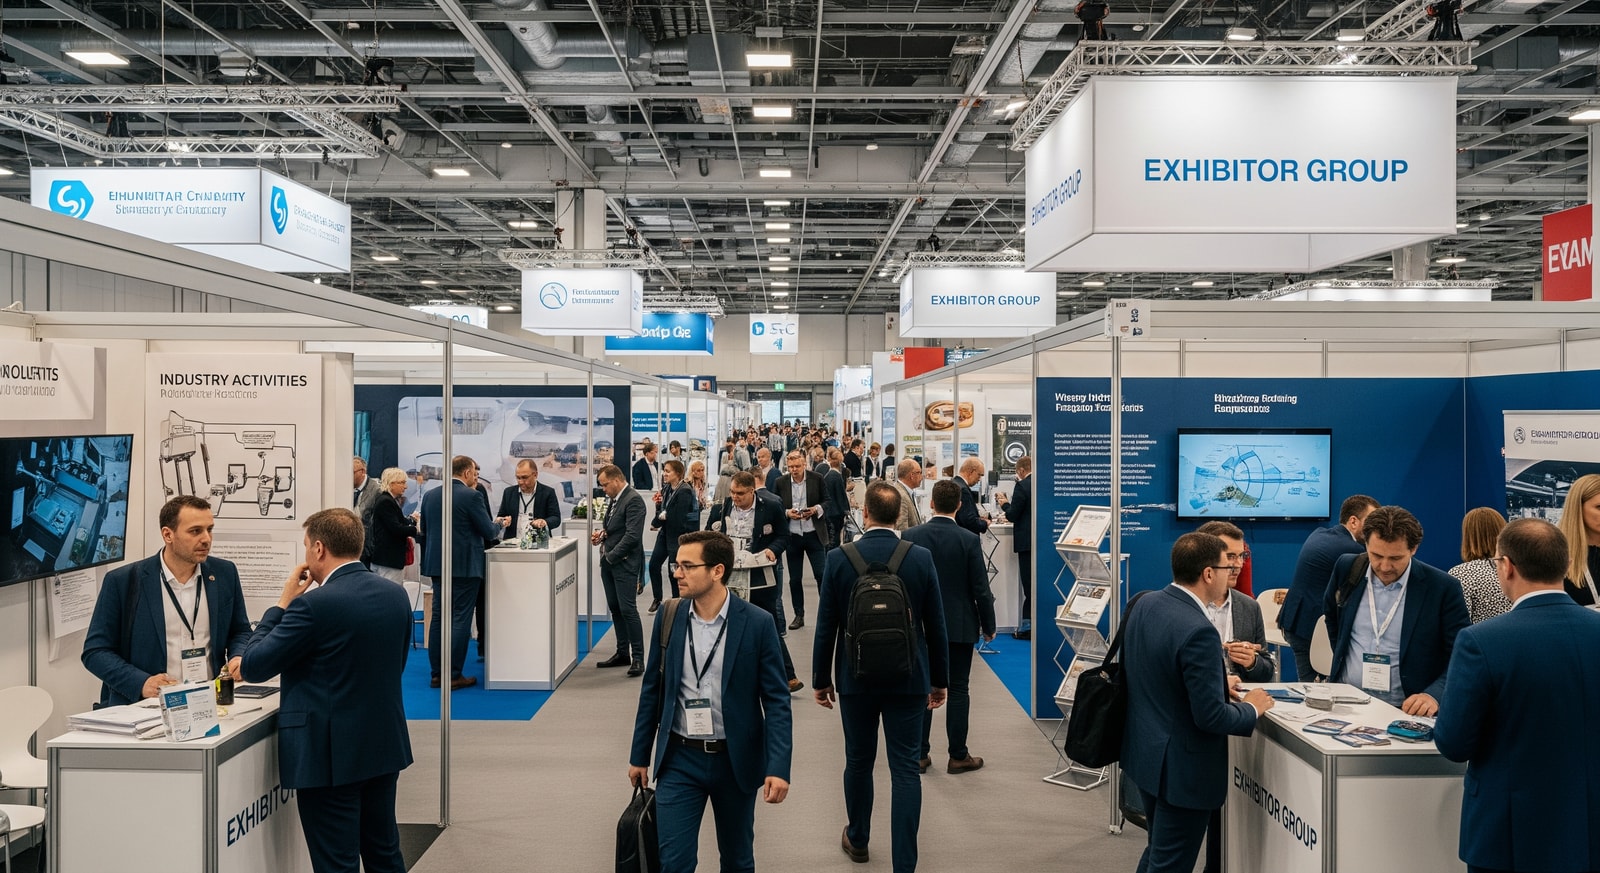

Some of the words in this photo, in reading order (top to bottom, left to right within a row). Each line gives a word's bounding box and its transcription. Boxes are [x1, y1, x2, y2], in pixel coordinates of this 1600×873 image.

[1144, 158, 1298, 182] EXHIBITOR
[1306, 158, 1408, 182] GROUP
[1059, 168, 1082, 205] GROUP
[931, 295, 995, 305] EXHIBITOR
[998, 295, 1041, 305] GROUP
[160, 373, 229, 386] INDUSTRY
[232, 374, 308, 387] ACTIVITIES
[227, 784, 297, 848] EXHIBITO
[1233, 766, 1281, 823] EXHIBITOR
[1281, 805, 1318, 851] GROUP
